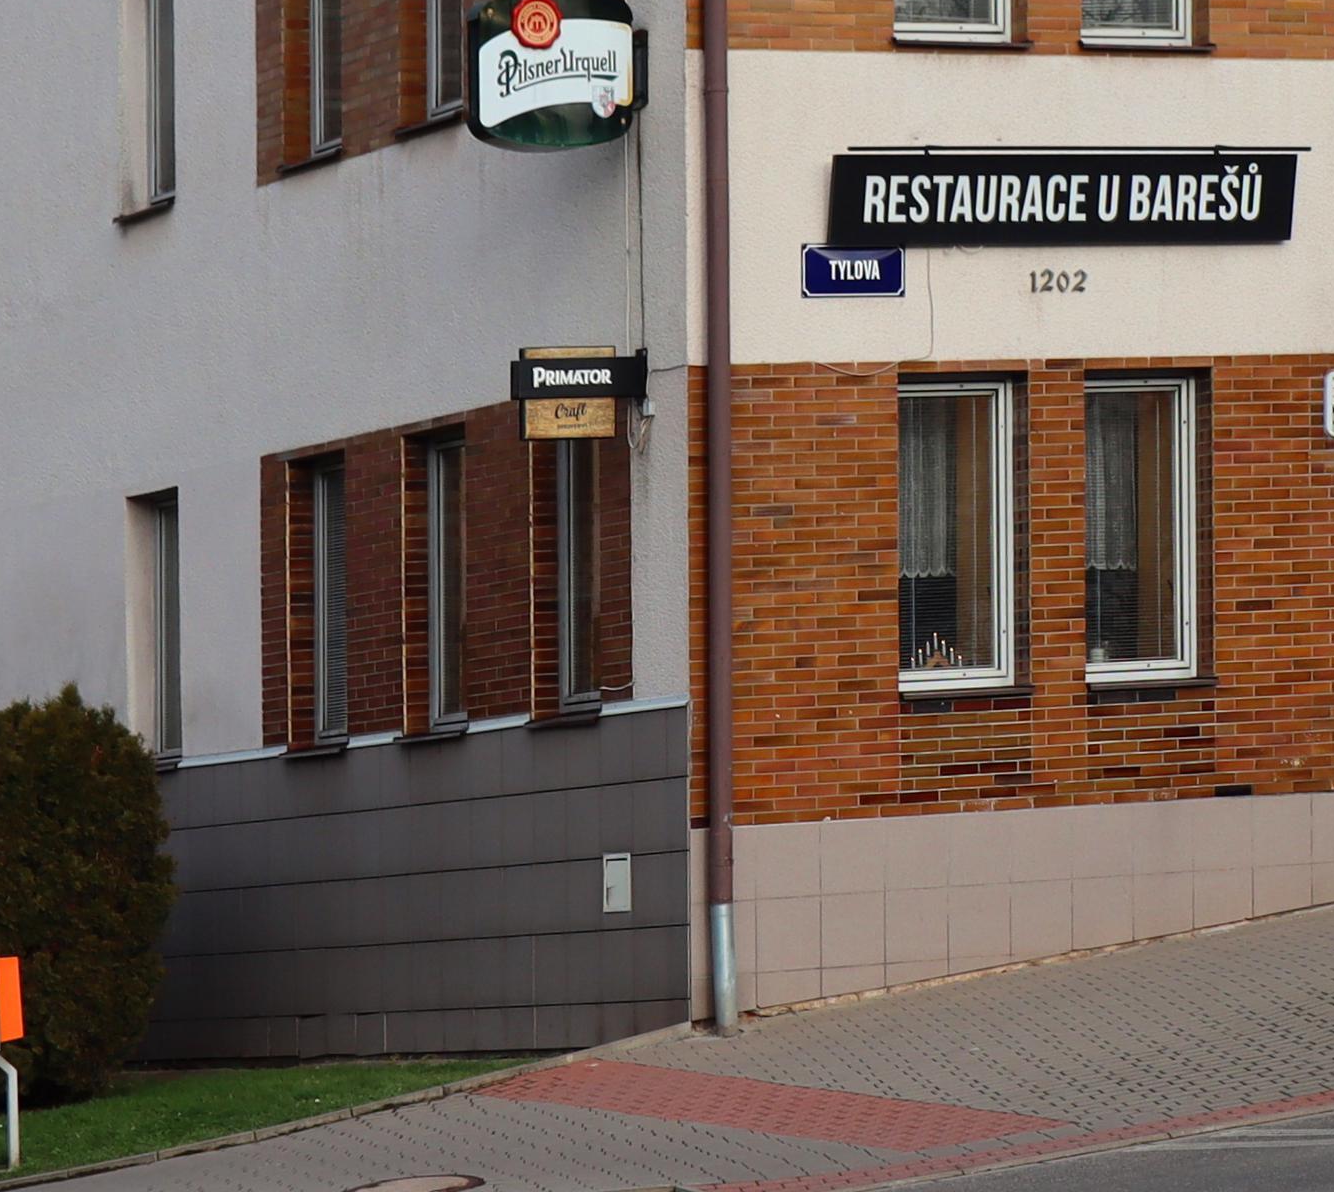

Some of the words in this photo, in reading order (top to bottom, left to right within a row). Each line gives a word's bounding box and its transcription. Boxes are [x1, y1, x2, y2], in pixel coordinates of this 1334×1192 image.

[497, 49, 561, 99] Pilsner
[560, 47, 617, 82] Urquell
[863, 173, 1087, 224] RESTAURACE
[1097, 174, 1119, 223] U
[1129, 161, 1263, 222] BAREŠŮ
[828, 259, 881, 281] TYLOVA
[1029, 268, 1088, 293] 1202
[532, 366, 612, 388] PRIMATOR
[555, 402, 587, 421] Craft
